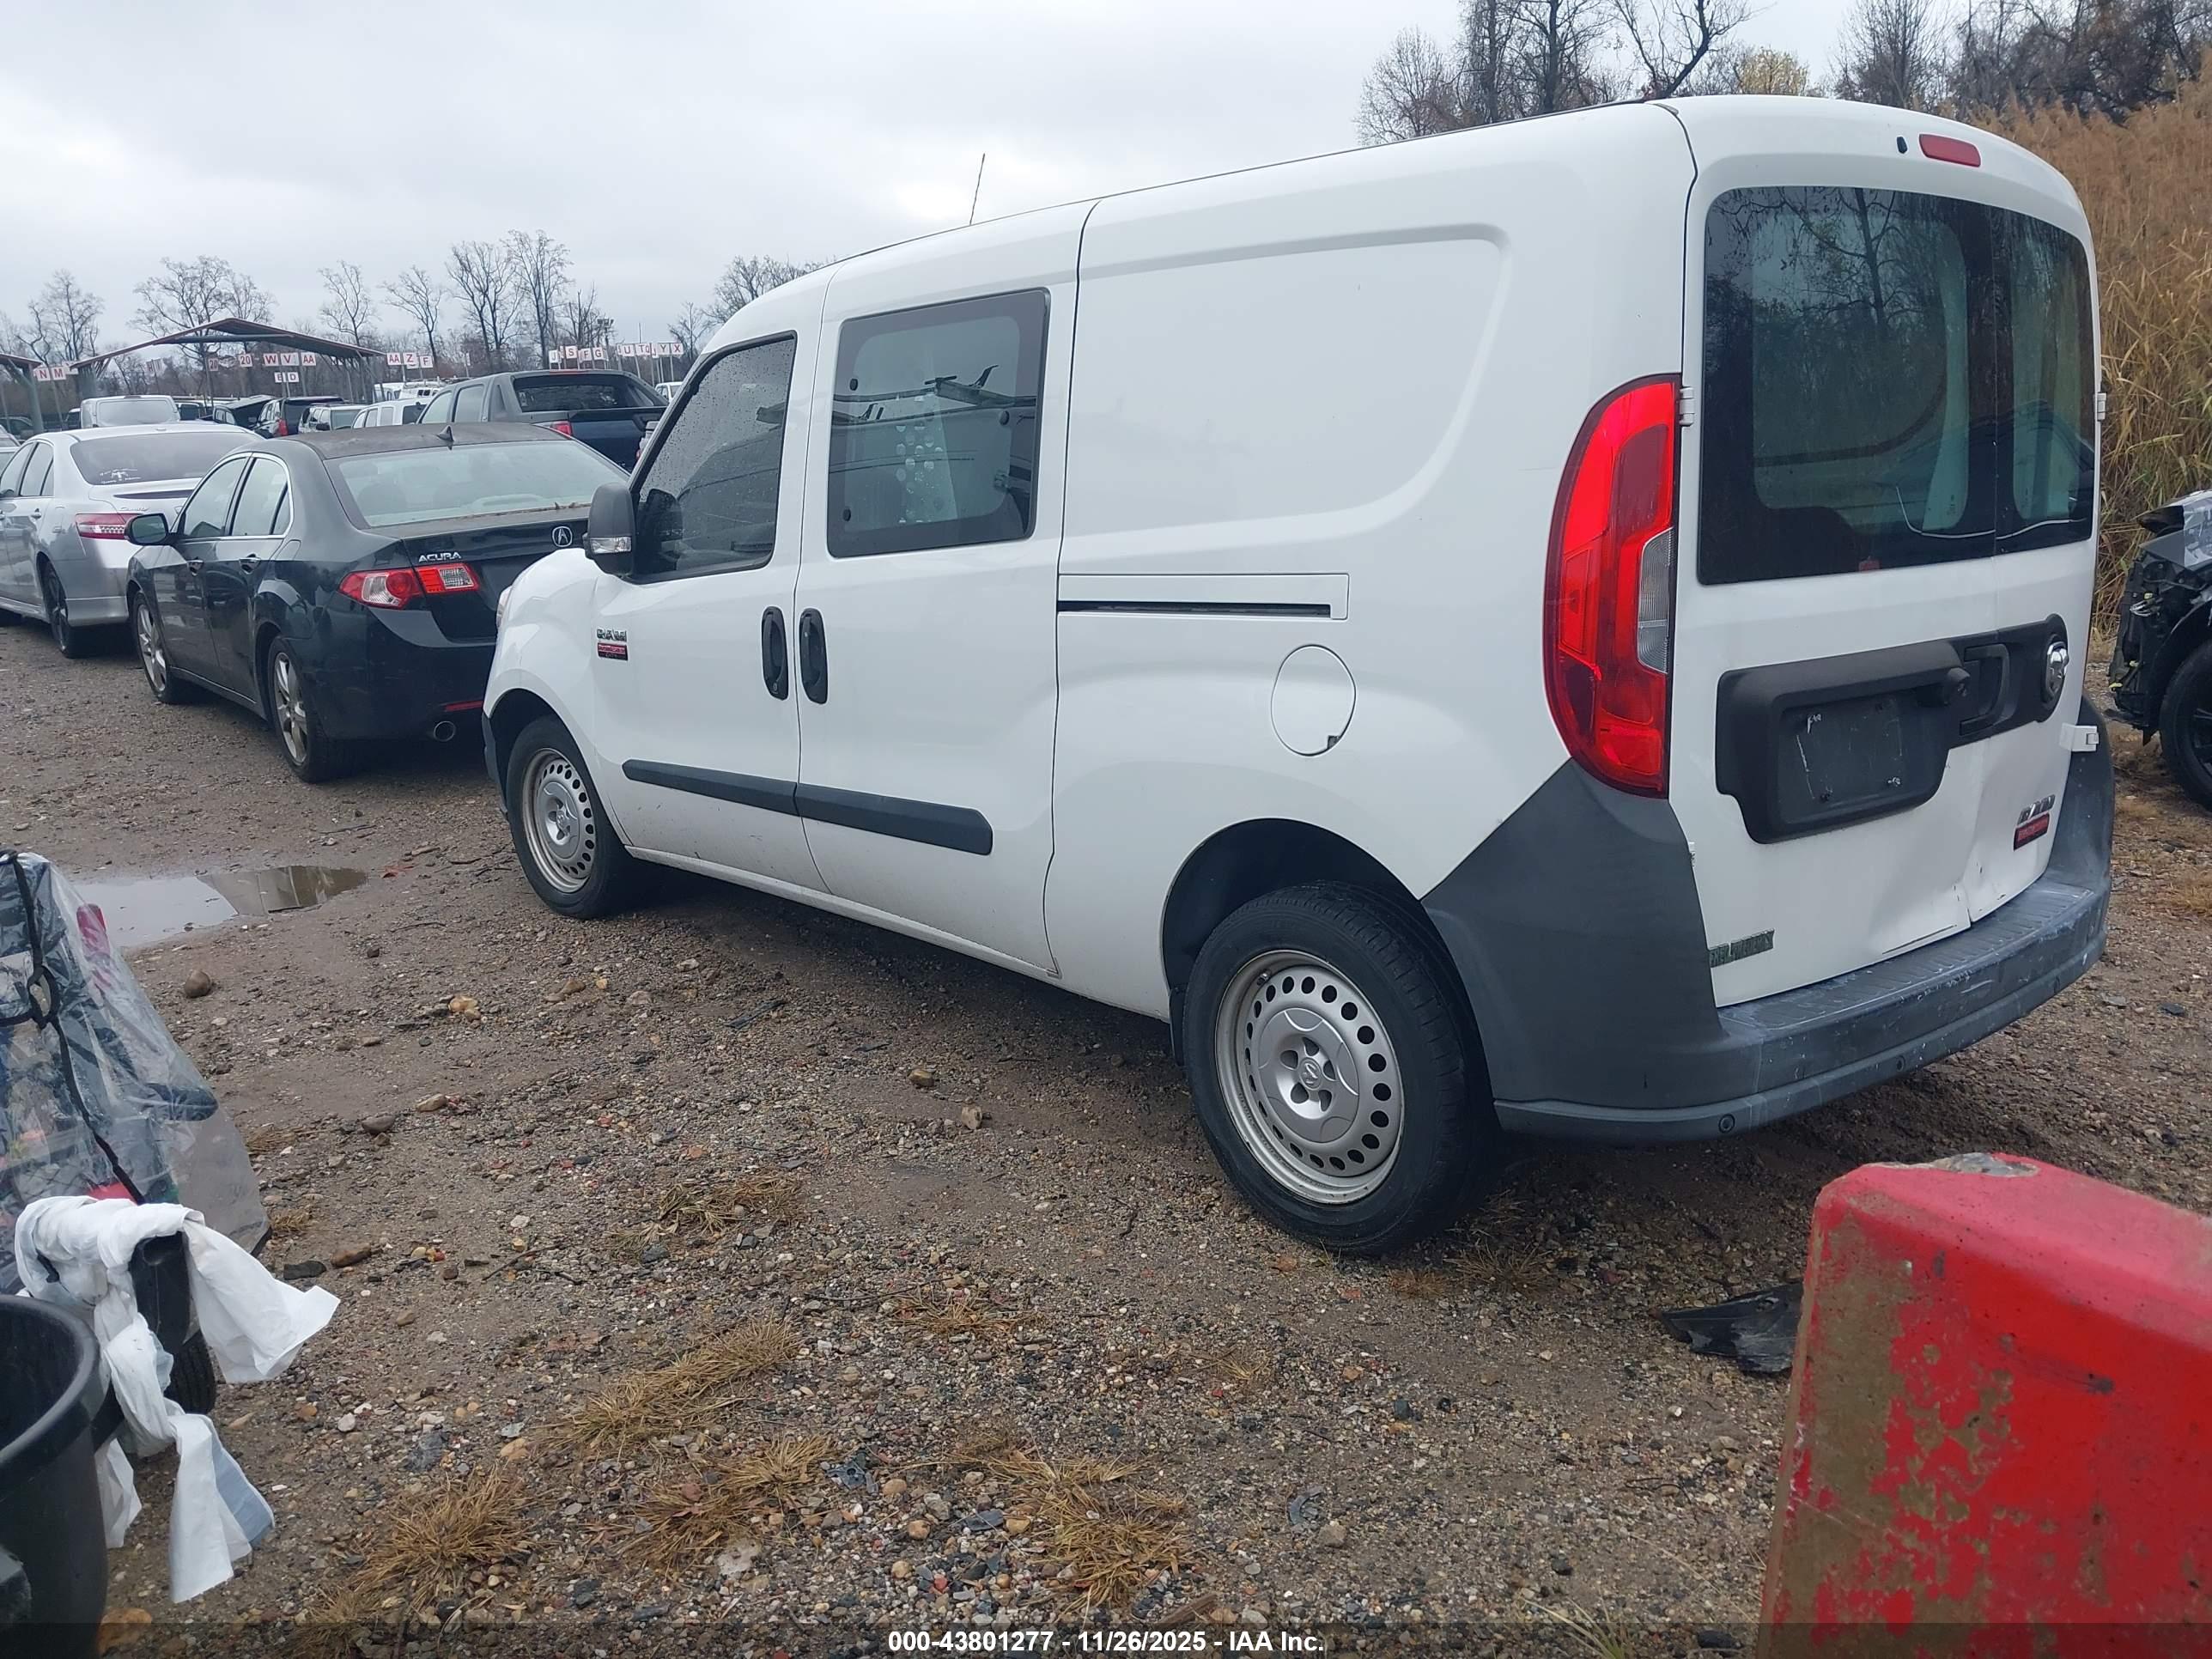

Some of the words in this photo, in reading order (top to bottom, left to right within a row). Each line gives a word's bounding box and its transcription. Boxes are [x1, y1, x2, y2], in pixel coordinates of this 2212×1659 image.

[568, 348, 574, 356] S
[639, 344, 645, 353] T
[389, 354, 400, 363] AA
[406, 354, 414, 362] Z
[584, 350, 589, 359] F
[241, 356, 251, 365] 20
[265, 355, 276, 364] W
[283, 355, 291, 364] V
[303, 356, 315, 364] AA
[210, 360, 219, 369] 20
[40, 370, 47, 379] N
[54, 368, 64, 378] M
[418, 551, 461, 562] ACURA
